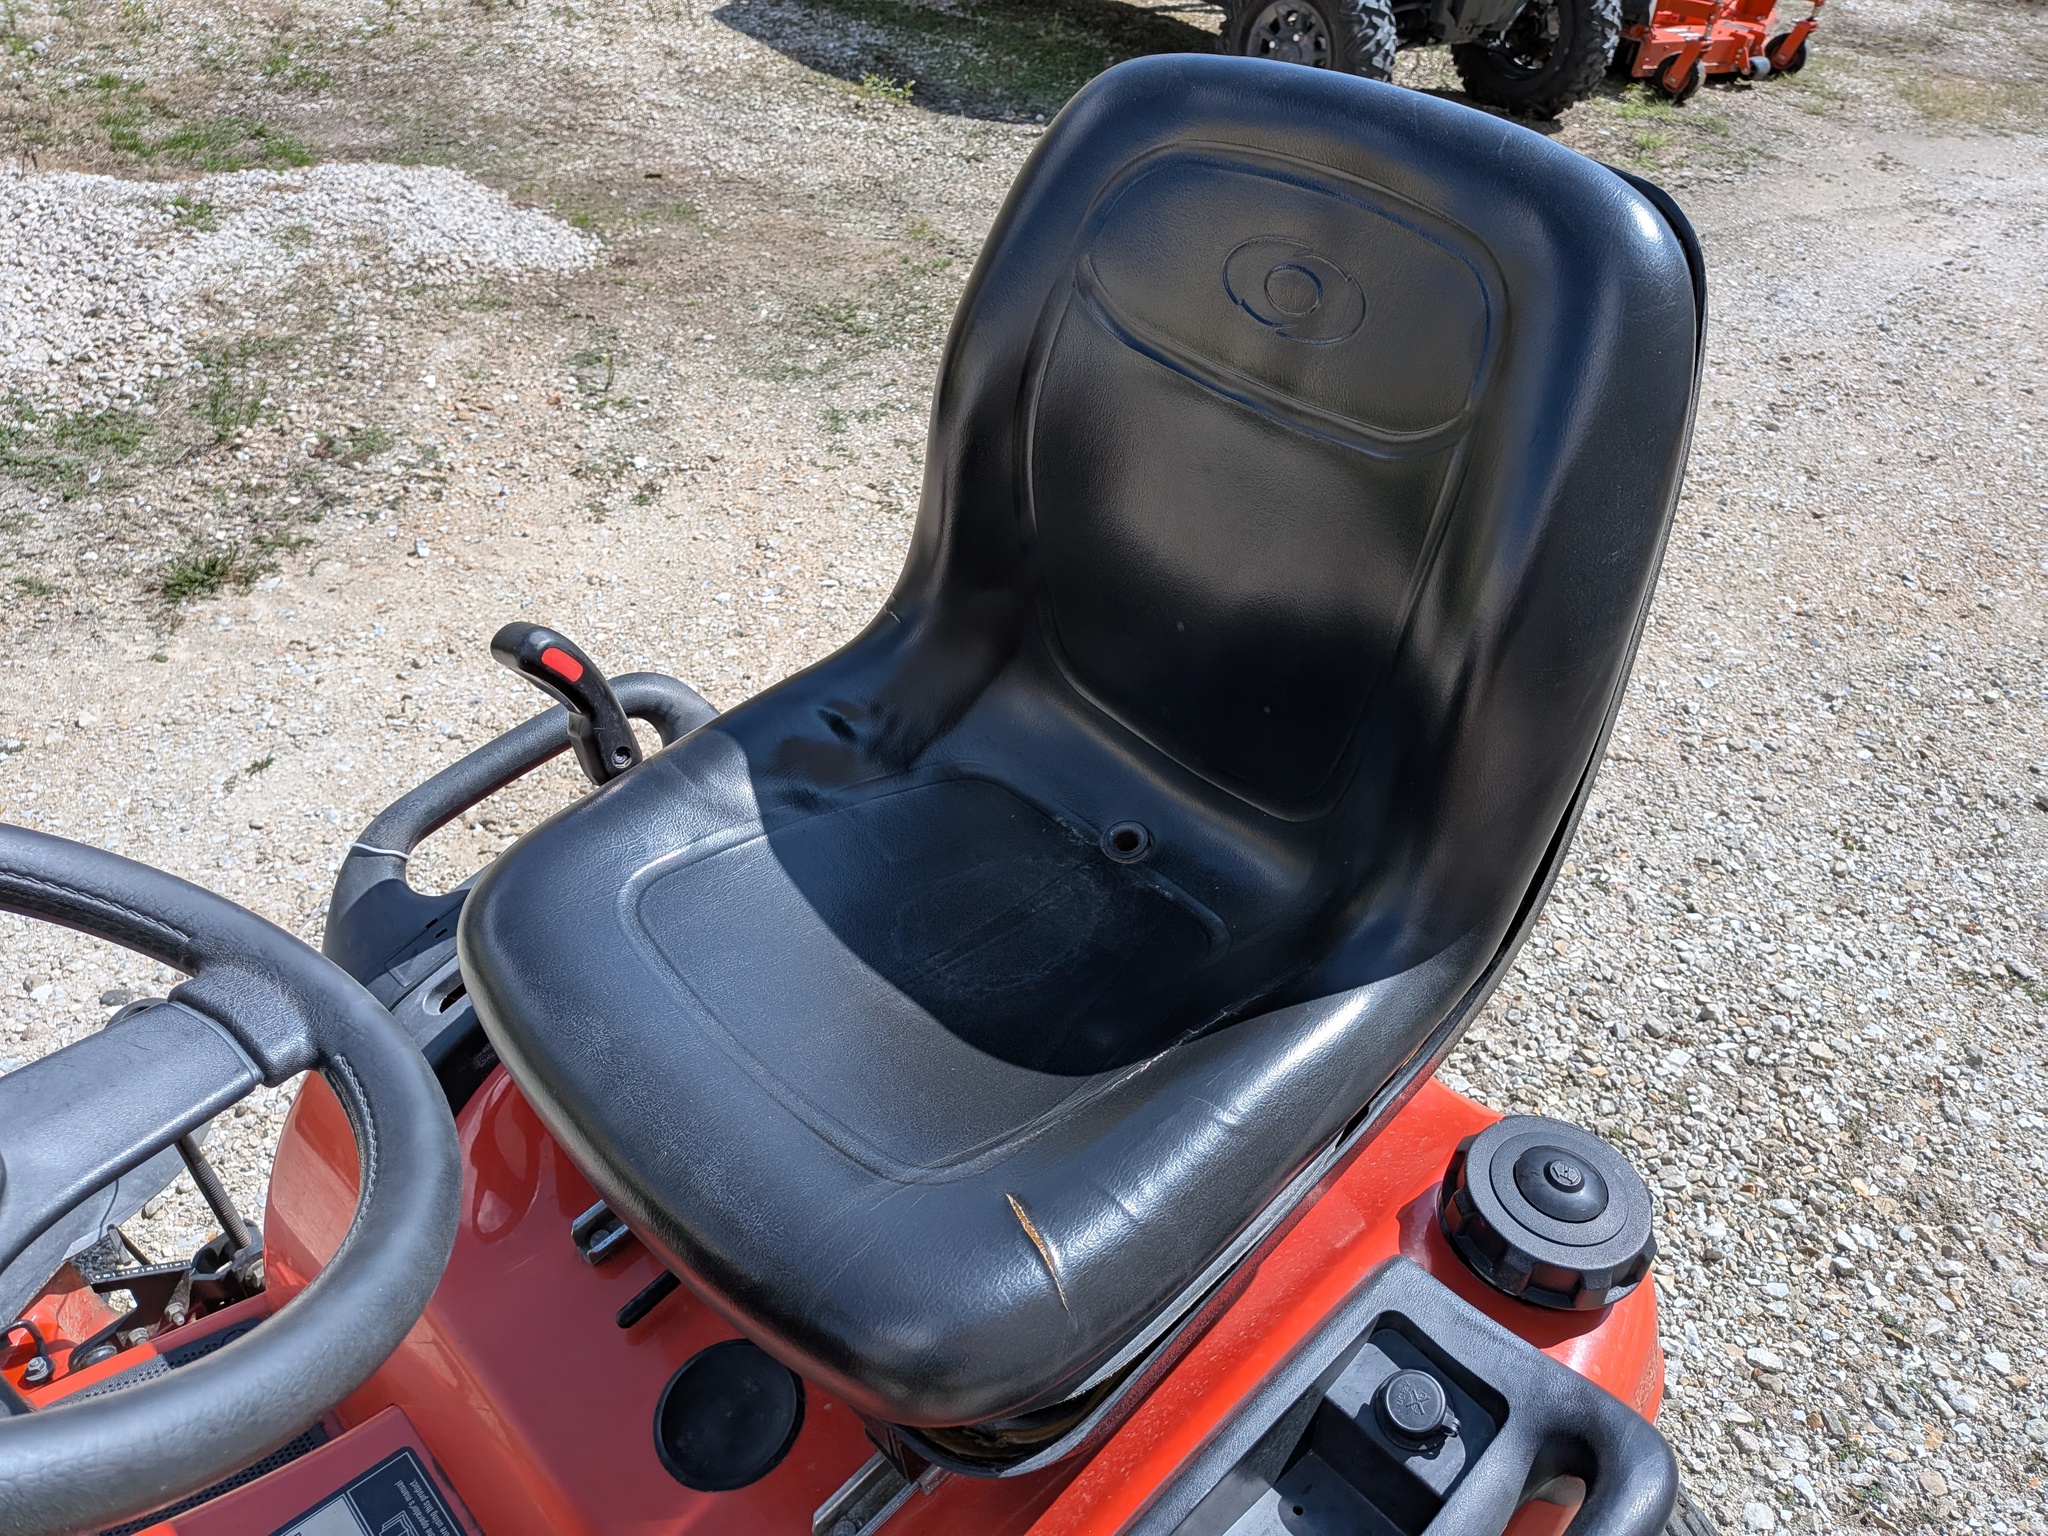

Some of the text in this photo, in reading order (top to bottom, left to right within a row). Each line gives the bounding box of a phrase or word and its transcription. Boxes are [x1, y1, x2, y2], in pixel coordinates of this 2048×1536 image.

[394, 1479, 413, 1502] manual
[409, 1477, 429, 1502] product.
[408, 1500, 430, 1529] operator's
[423, 1500, 434, 1514] this
[429, 1510, 444, 1528] using
